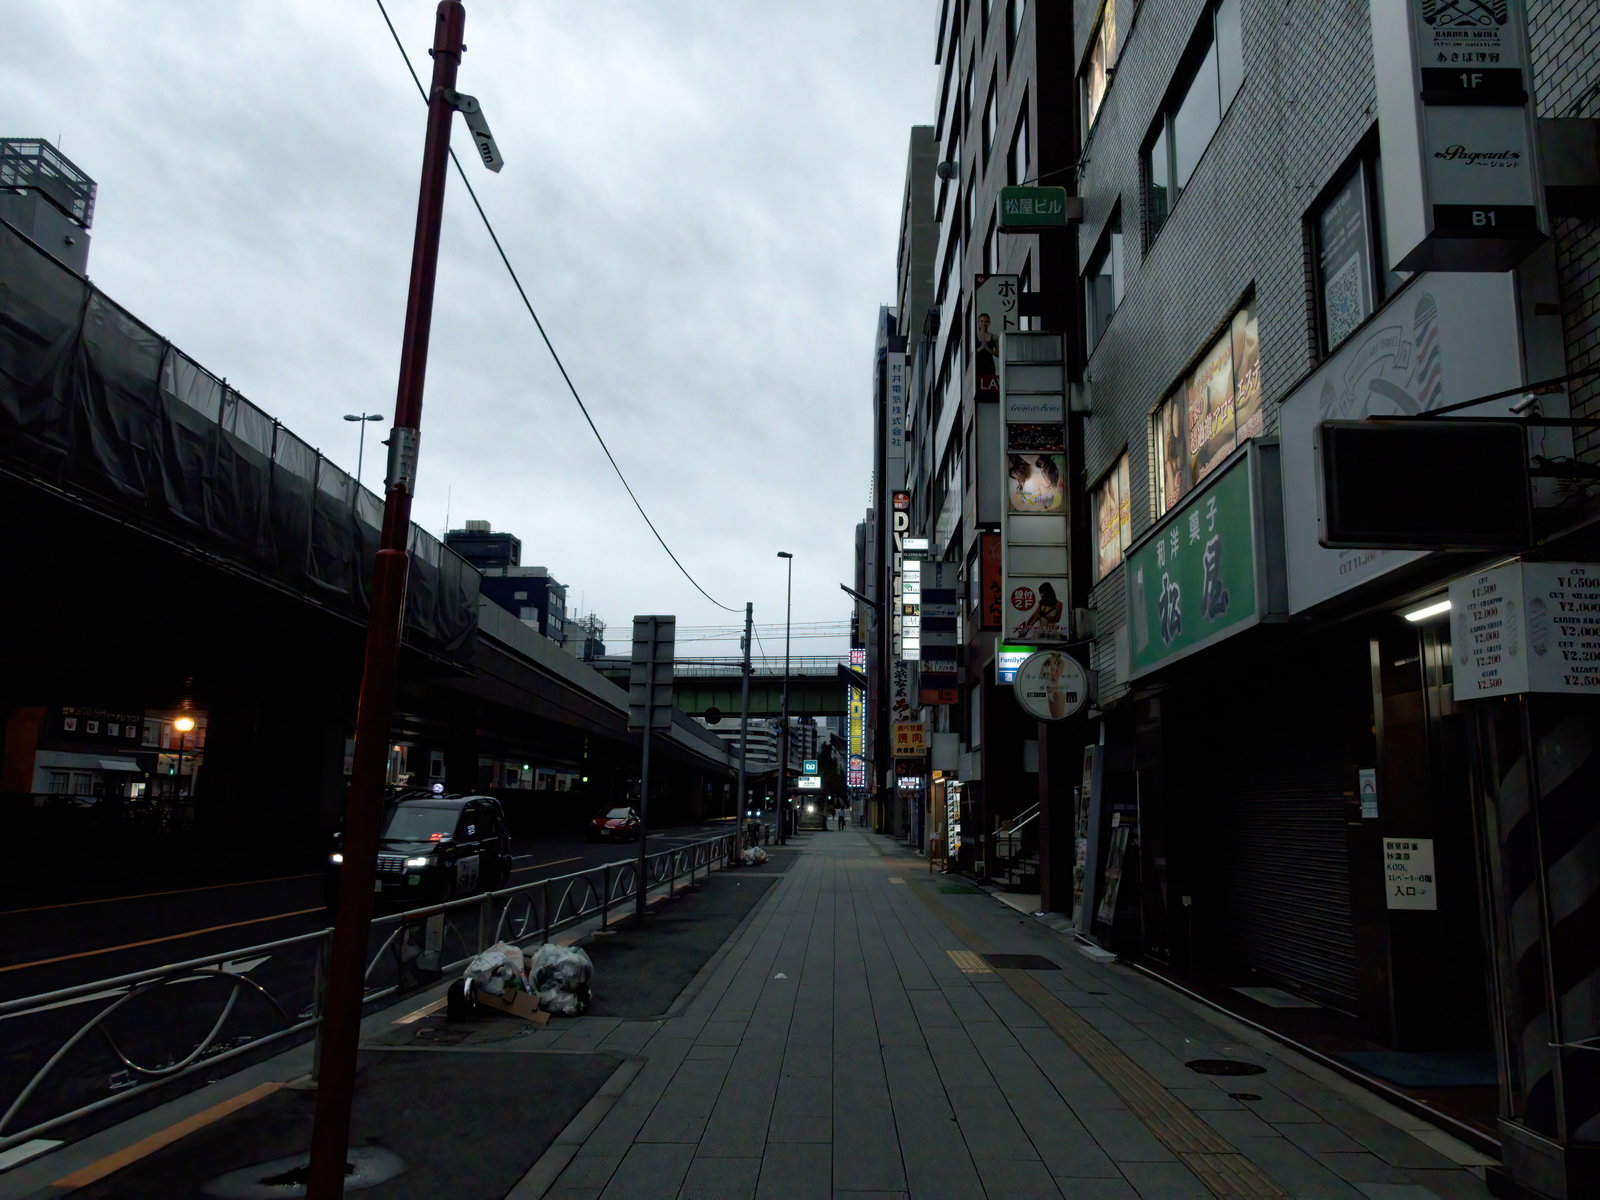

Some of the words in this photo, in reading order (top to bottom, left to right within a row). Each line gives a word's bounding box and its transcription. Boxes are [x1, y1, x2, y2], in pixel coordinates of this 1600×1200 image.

[1459, 73, 1483, 88] 1F
[1005, 198, 1062, 216] 松屋ビル
[1472, 210, 1496, 226] B1
[998, 281, 1015, 331] ホット
[1014, 599, 1033, 609] 2F
[1387, 863, 1407, 871] KOOL
[1394, 886, 1415, 896] 入口
